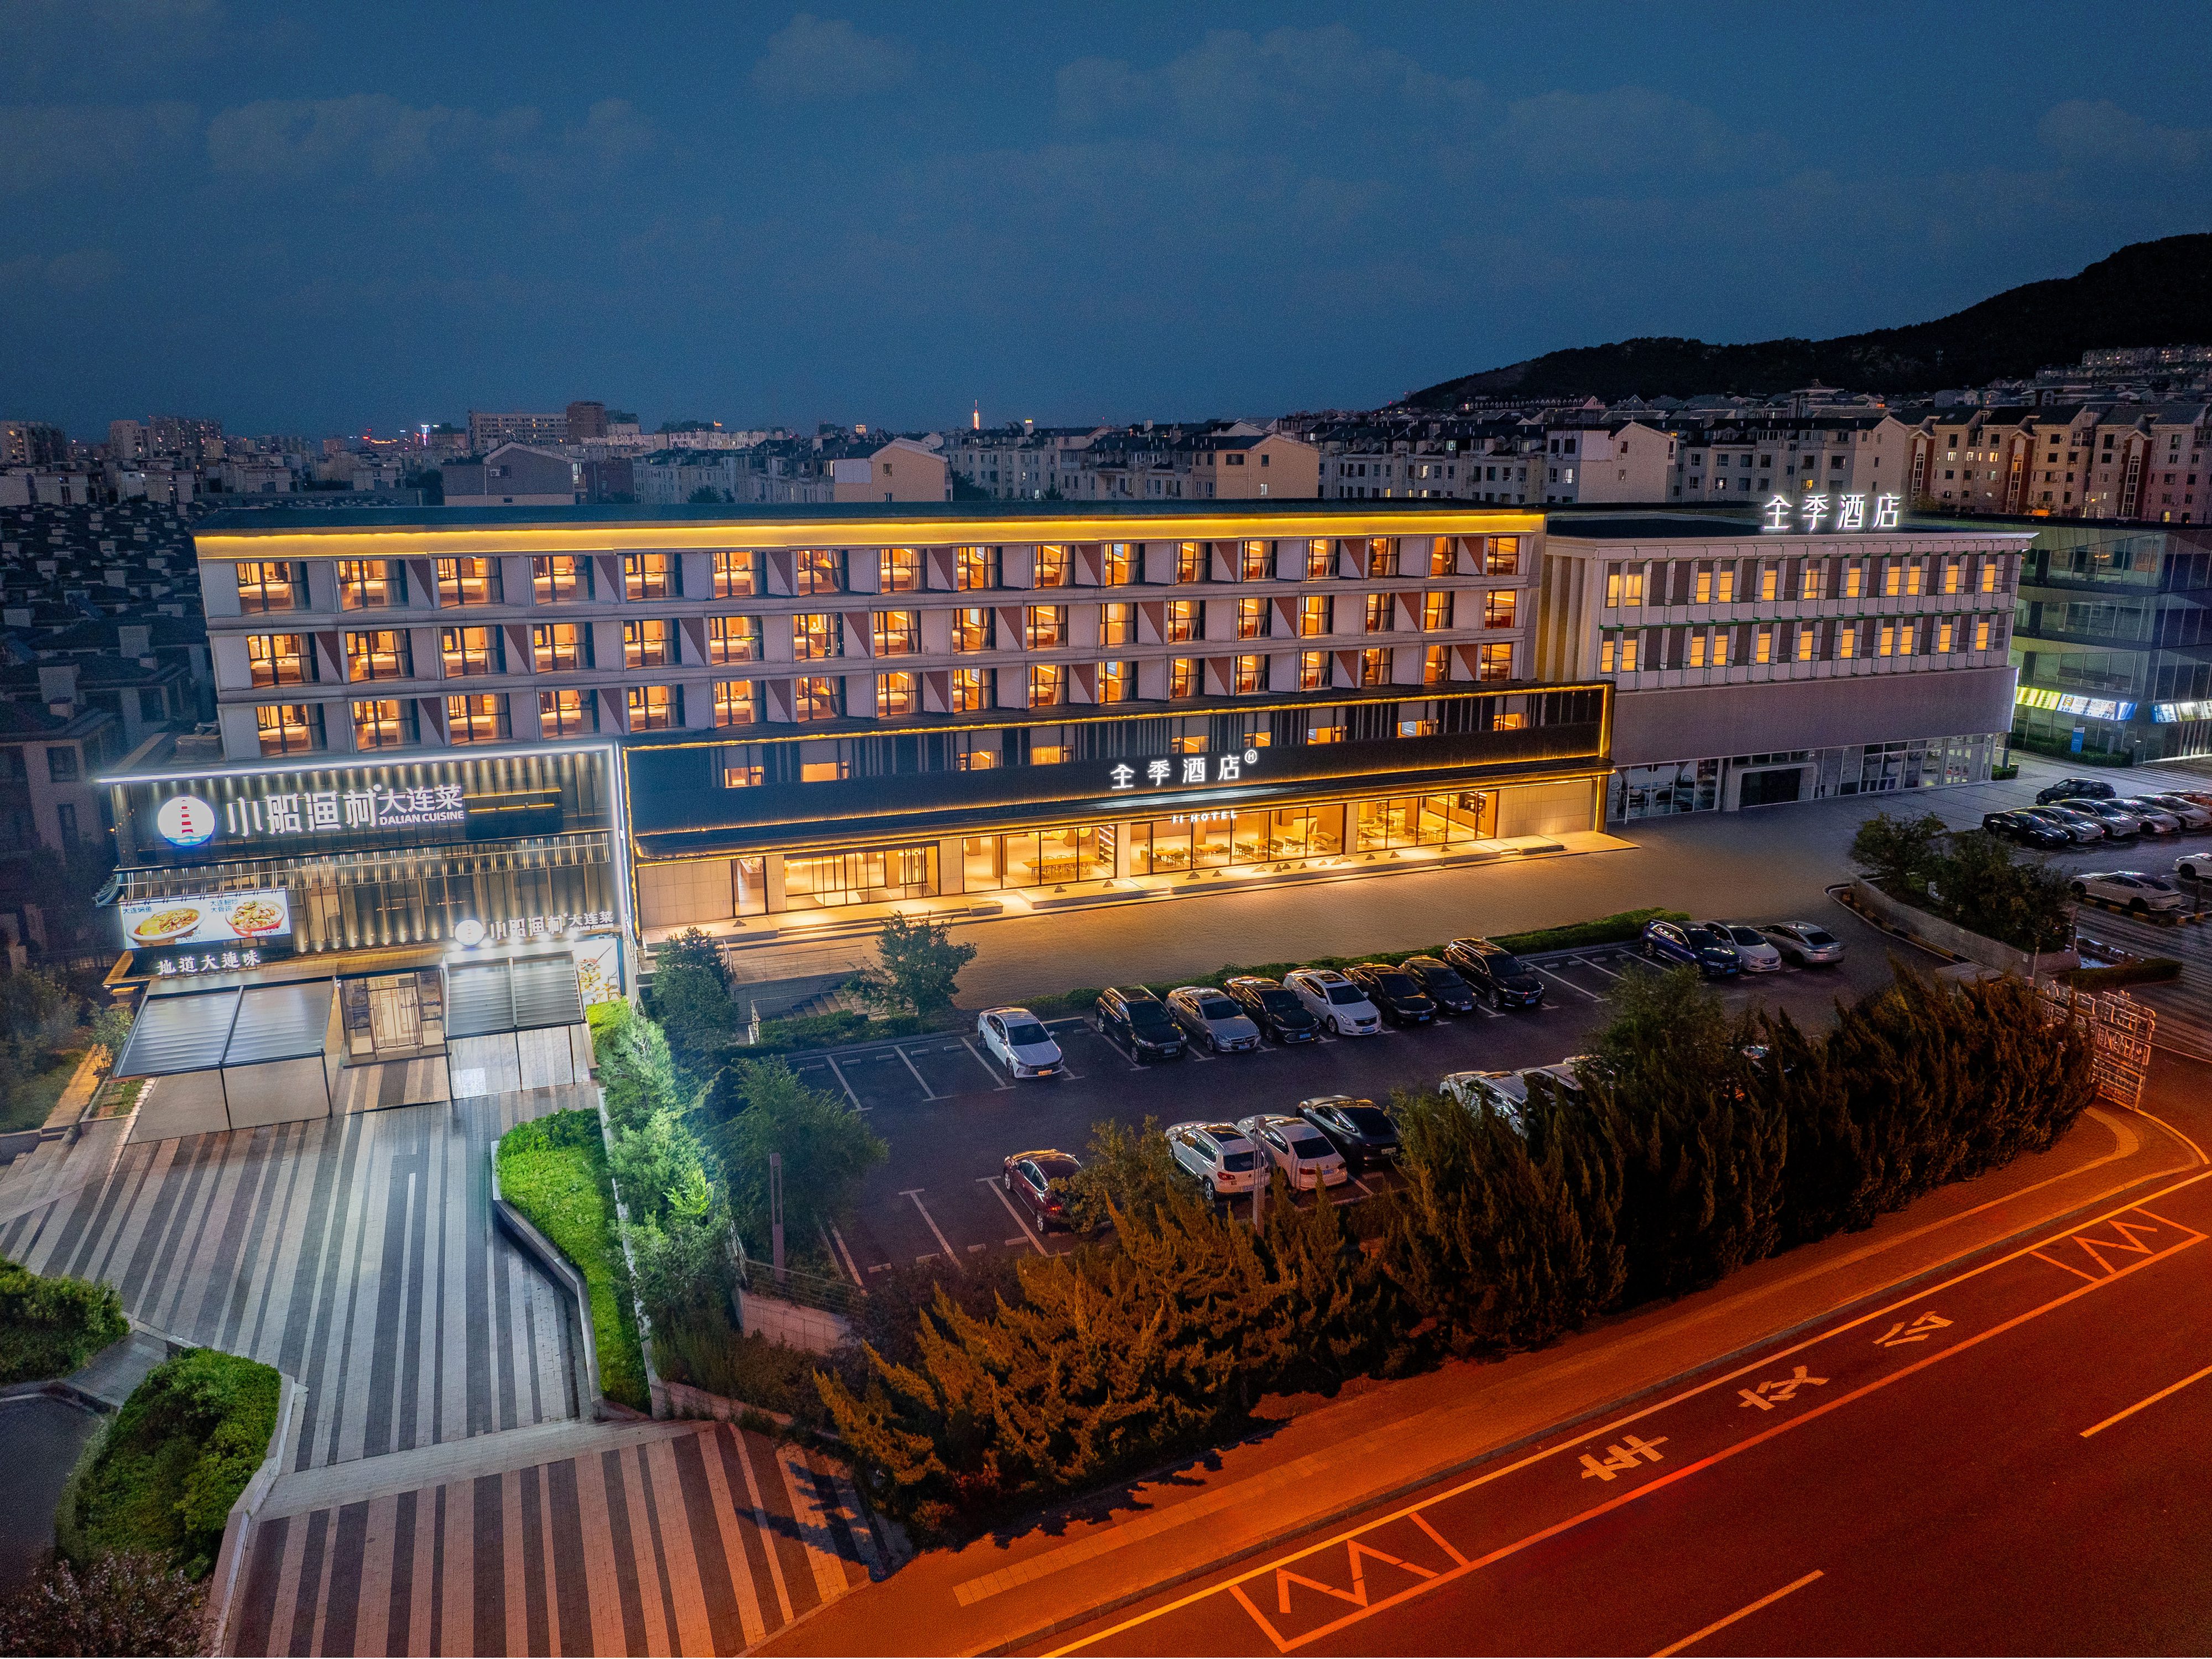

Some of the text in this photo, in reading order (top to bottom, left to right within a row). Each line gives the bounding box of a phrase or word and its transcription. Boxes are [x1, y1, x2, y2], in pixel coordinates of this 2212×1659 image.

[1763, 493, 1901, 530] 全季酒店
[1110, 755, 1240, 789] 全季酒店
[227, 783, 463, 837] 小船渔村 大连菜
[379, 811, 465, 826] DALIAN CUISINE
[1190, 810, 1237, 823] HOTEL
[491, 915, 564, 940] 小船渔村
[568, 911, 614, 927] 大连菜
[156, 950, 261, 975] 地道大連味
